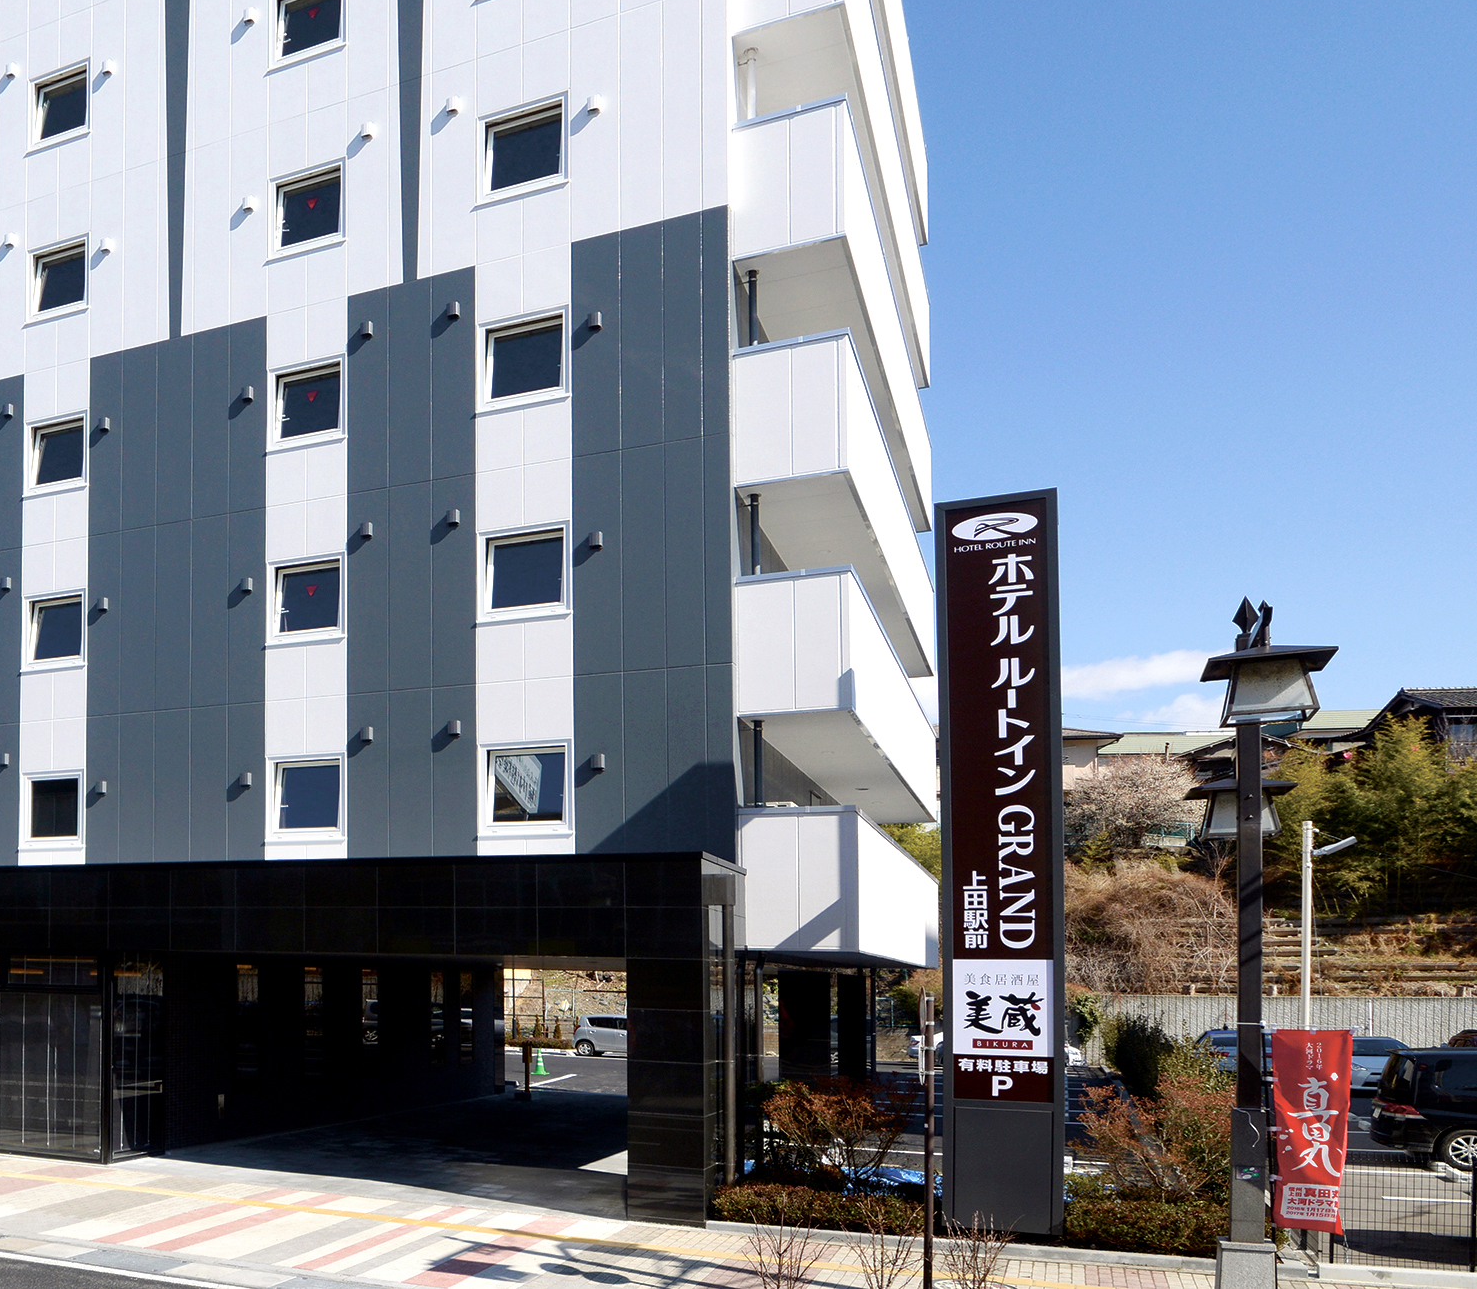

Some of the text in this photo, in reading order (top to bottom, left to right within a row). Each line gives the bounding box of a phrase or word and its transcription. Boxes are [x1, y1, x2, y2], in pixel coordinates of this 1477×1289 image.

[953, 537, 1037, 553] HOTEL ROUTE INN
[988, 553, 1036, 950] ホテル ルートイン GRAND
[962, 870, 989, 950] 上田駅前
[964, 973, 1040, 987] 美食居酒屋
[963, 990, 1045, 1037] 美蔵
[976, 1040, 1029, 1049] BIKURA
[958, 1057, 1049, 1074] 有料駐車場
[1305, 1042, 1314, 1070] 大河ドラマ
[991, 1075, 1014, 1097] P
